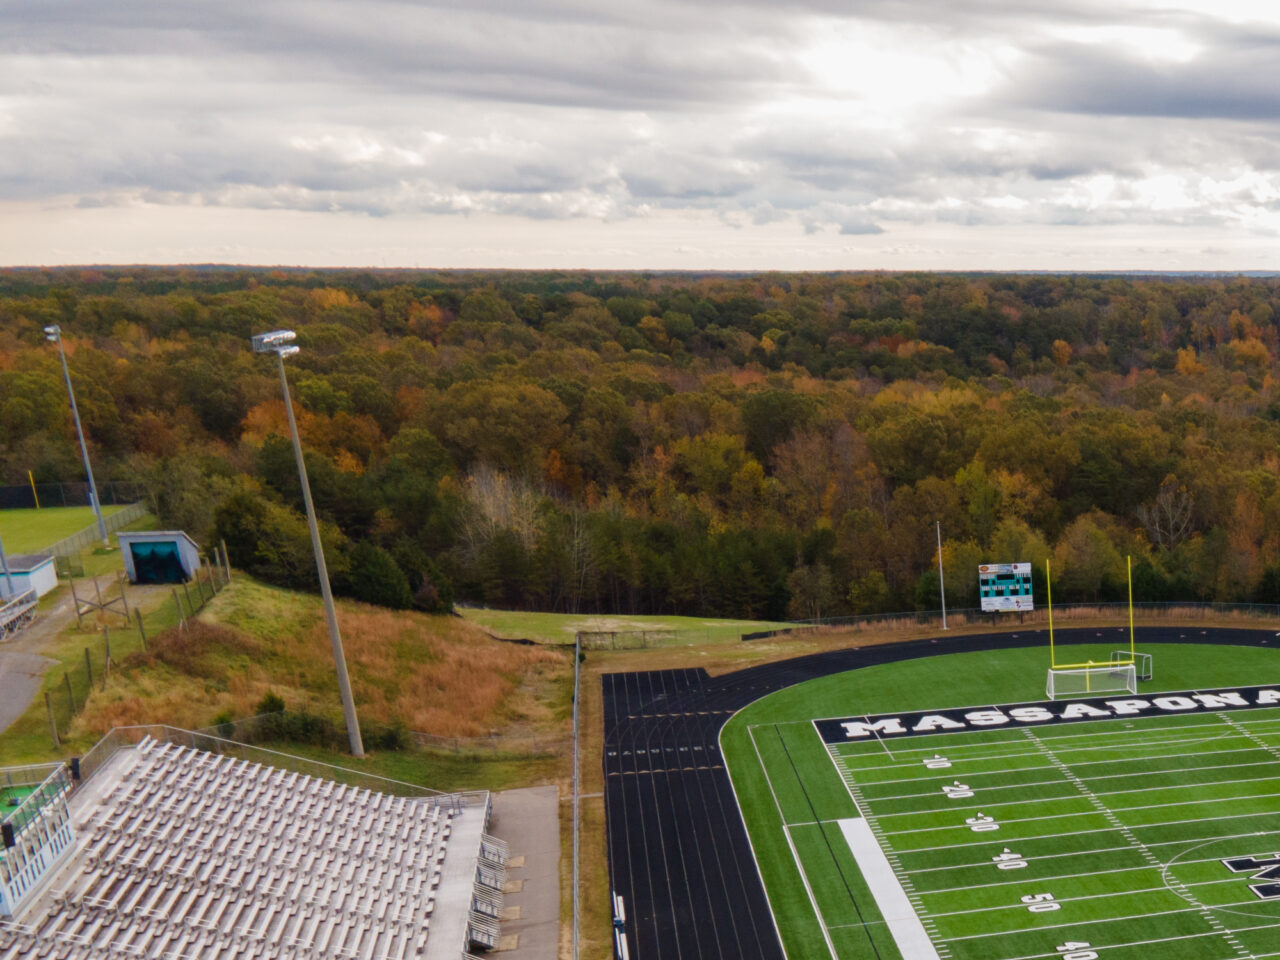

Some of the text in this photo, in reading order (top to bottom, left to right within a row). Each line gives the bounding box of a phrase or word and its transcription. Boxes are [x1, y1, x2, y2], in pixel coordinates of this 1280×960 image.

[942, 784, 975, 799] 20
[965, 816, 1000, 832] 30
[992, 853, 1028, 870] 40
[1020, 893, 1062, 912] 50
